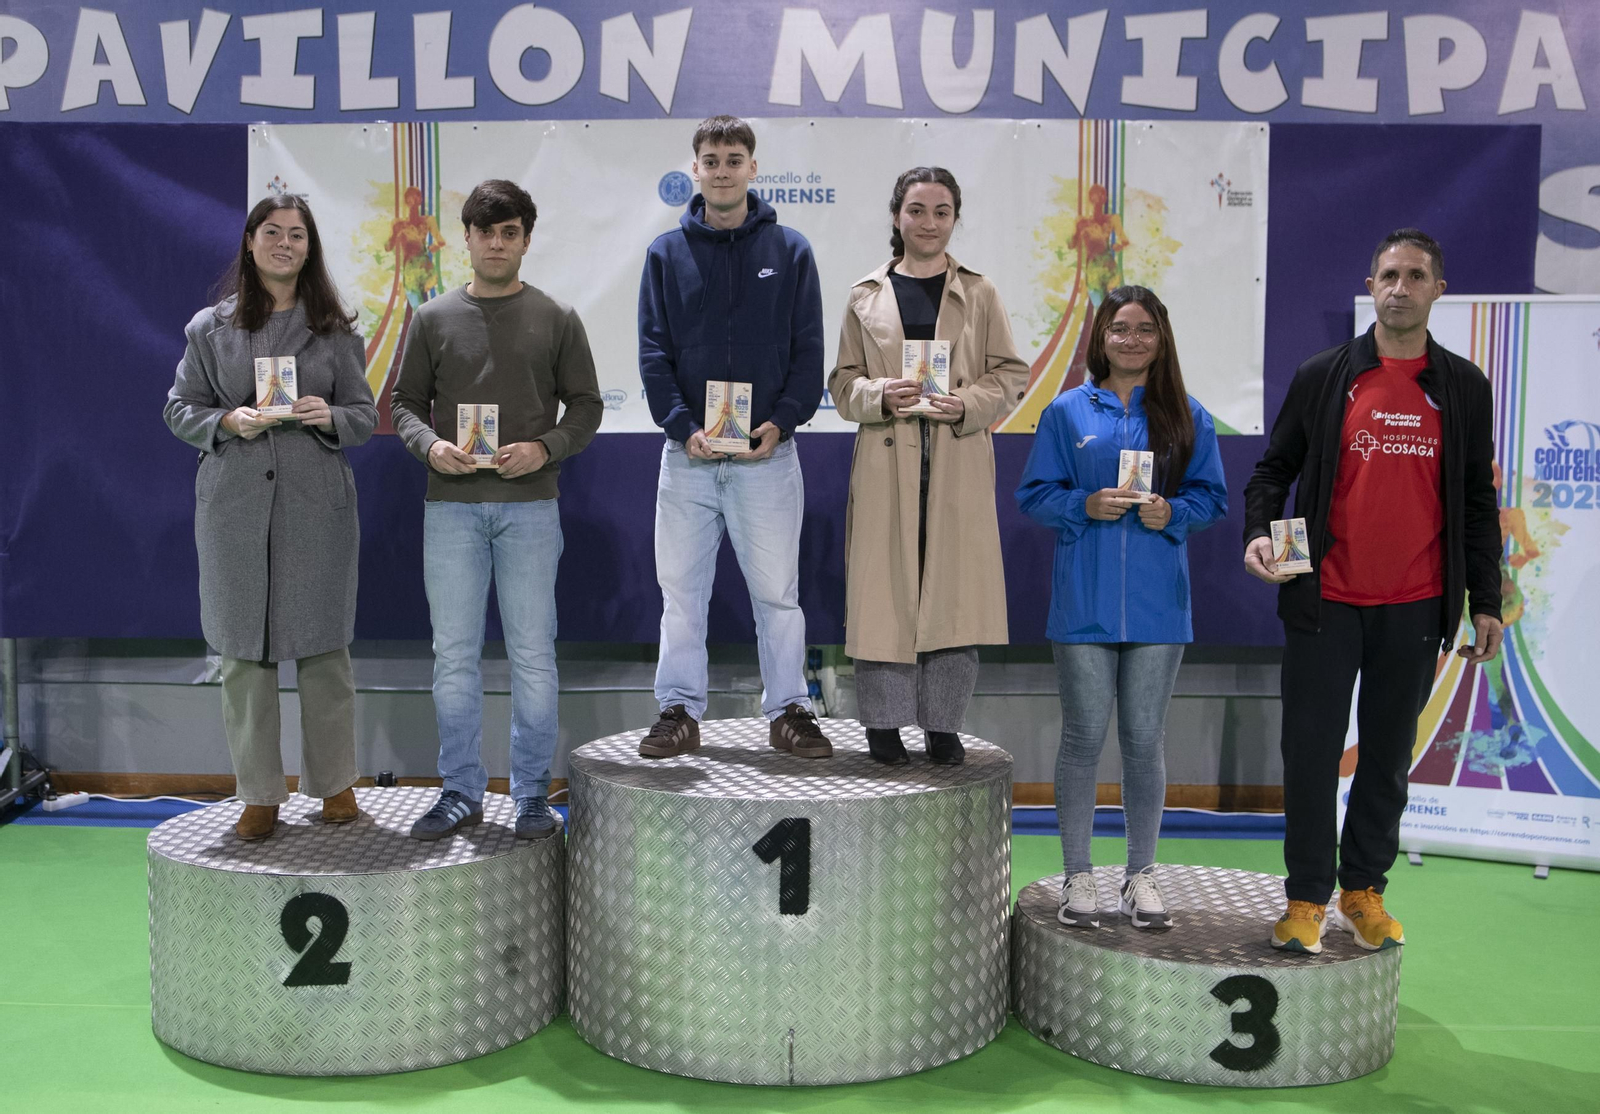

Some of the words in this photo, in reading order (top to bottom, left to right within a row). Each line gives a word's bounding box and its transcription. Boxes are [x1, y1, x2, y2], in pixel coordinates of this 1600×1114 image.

[0, 3, 694, 115] PAVILLON
[768, 8, 1587, 117] MUNICIPA
[748, 172, 801, 184] oncello
[806, 172, 821, 184] de
[1382, 442, 1434, 458] COSAGA
[1383, 434, 1438, 445] HOSPITALES
[1535, 448, 1600, 466] corren
[1533, 482, 1600, 509] 202
[1404, 804, 1447, 816] RENSE
[752, 817, 811, 916] 1
[279, 892, 353, 988] 2
[1208, 974, 1281, 1073] 3
